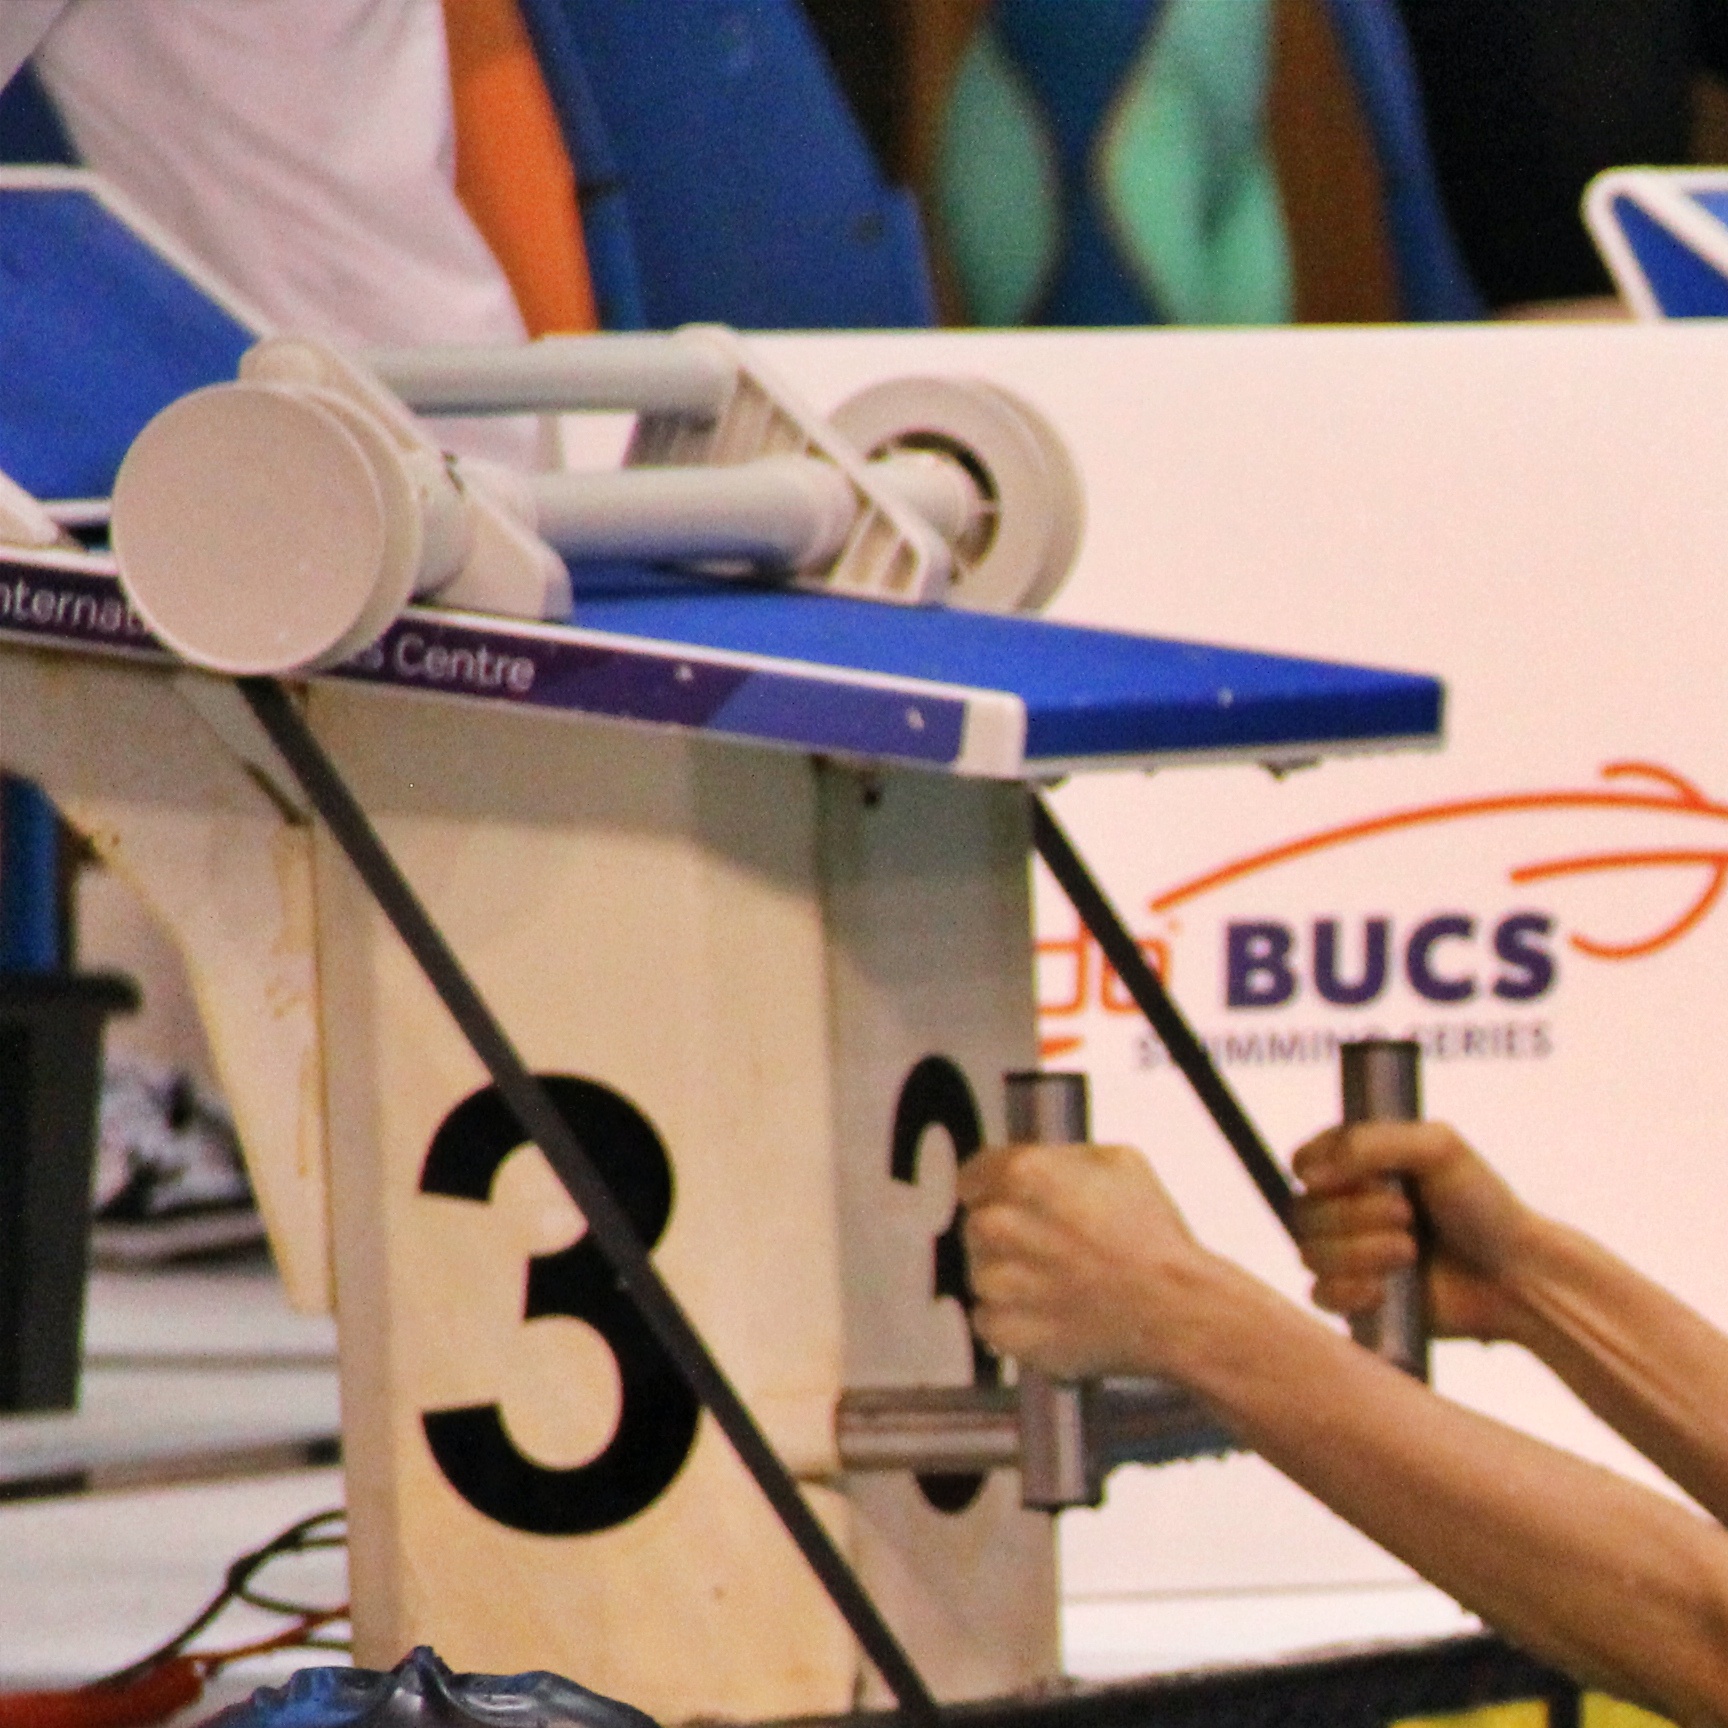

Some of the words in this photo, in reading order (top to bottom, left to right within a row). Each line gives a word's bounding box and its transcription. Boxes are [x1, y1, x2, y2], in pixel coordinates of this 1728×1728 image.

[395, 632, 534, 694] Centre
[1225, 911, 1557, 1011] BUCS
[418, 1072, 702, 1538] 3
